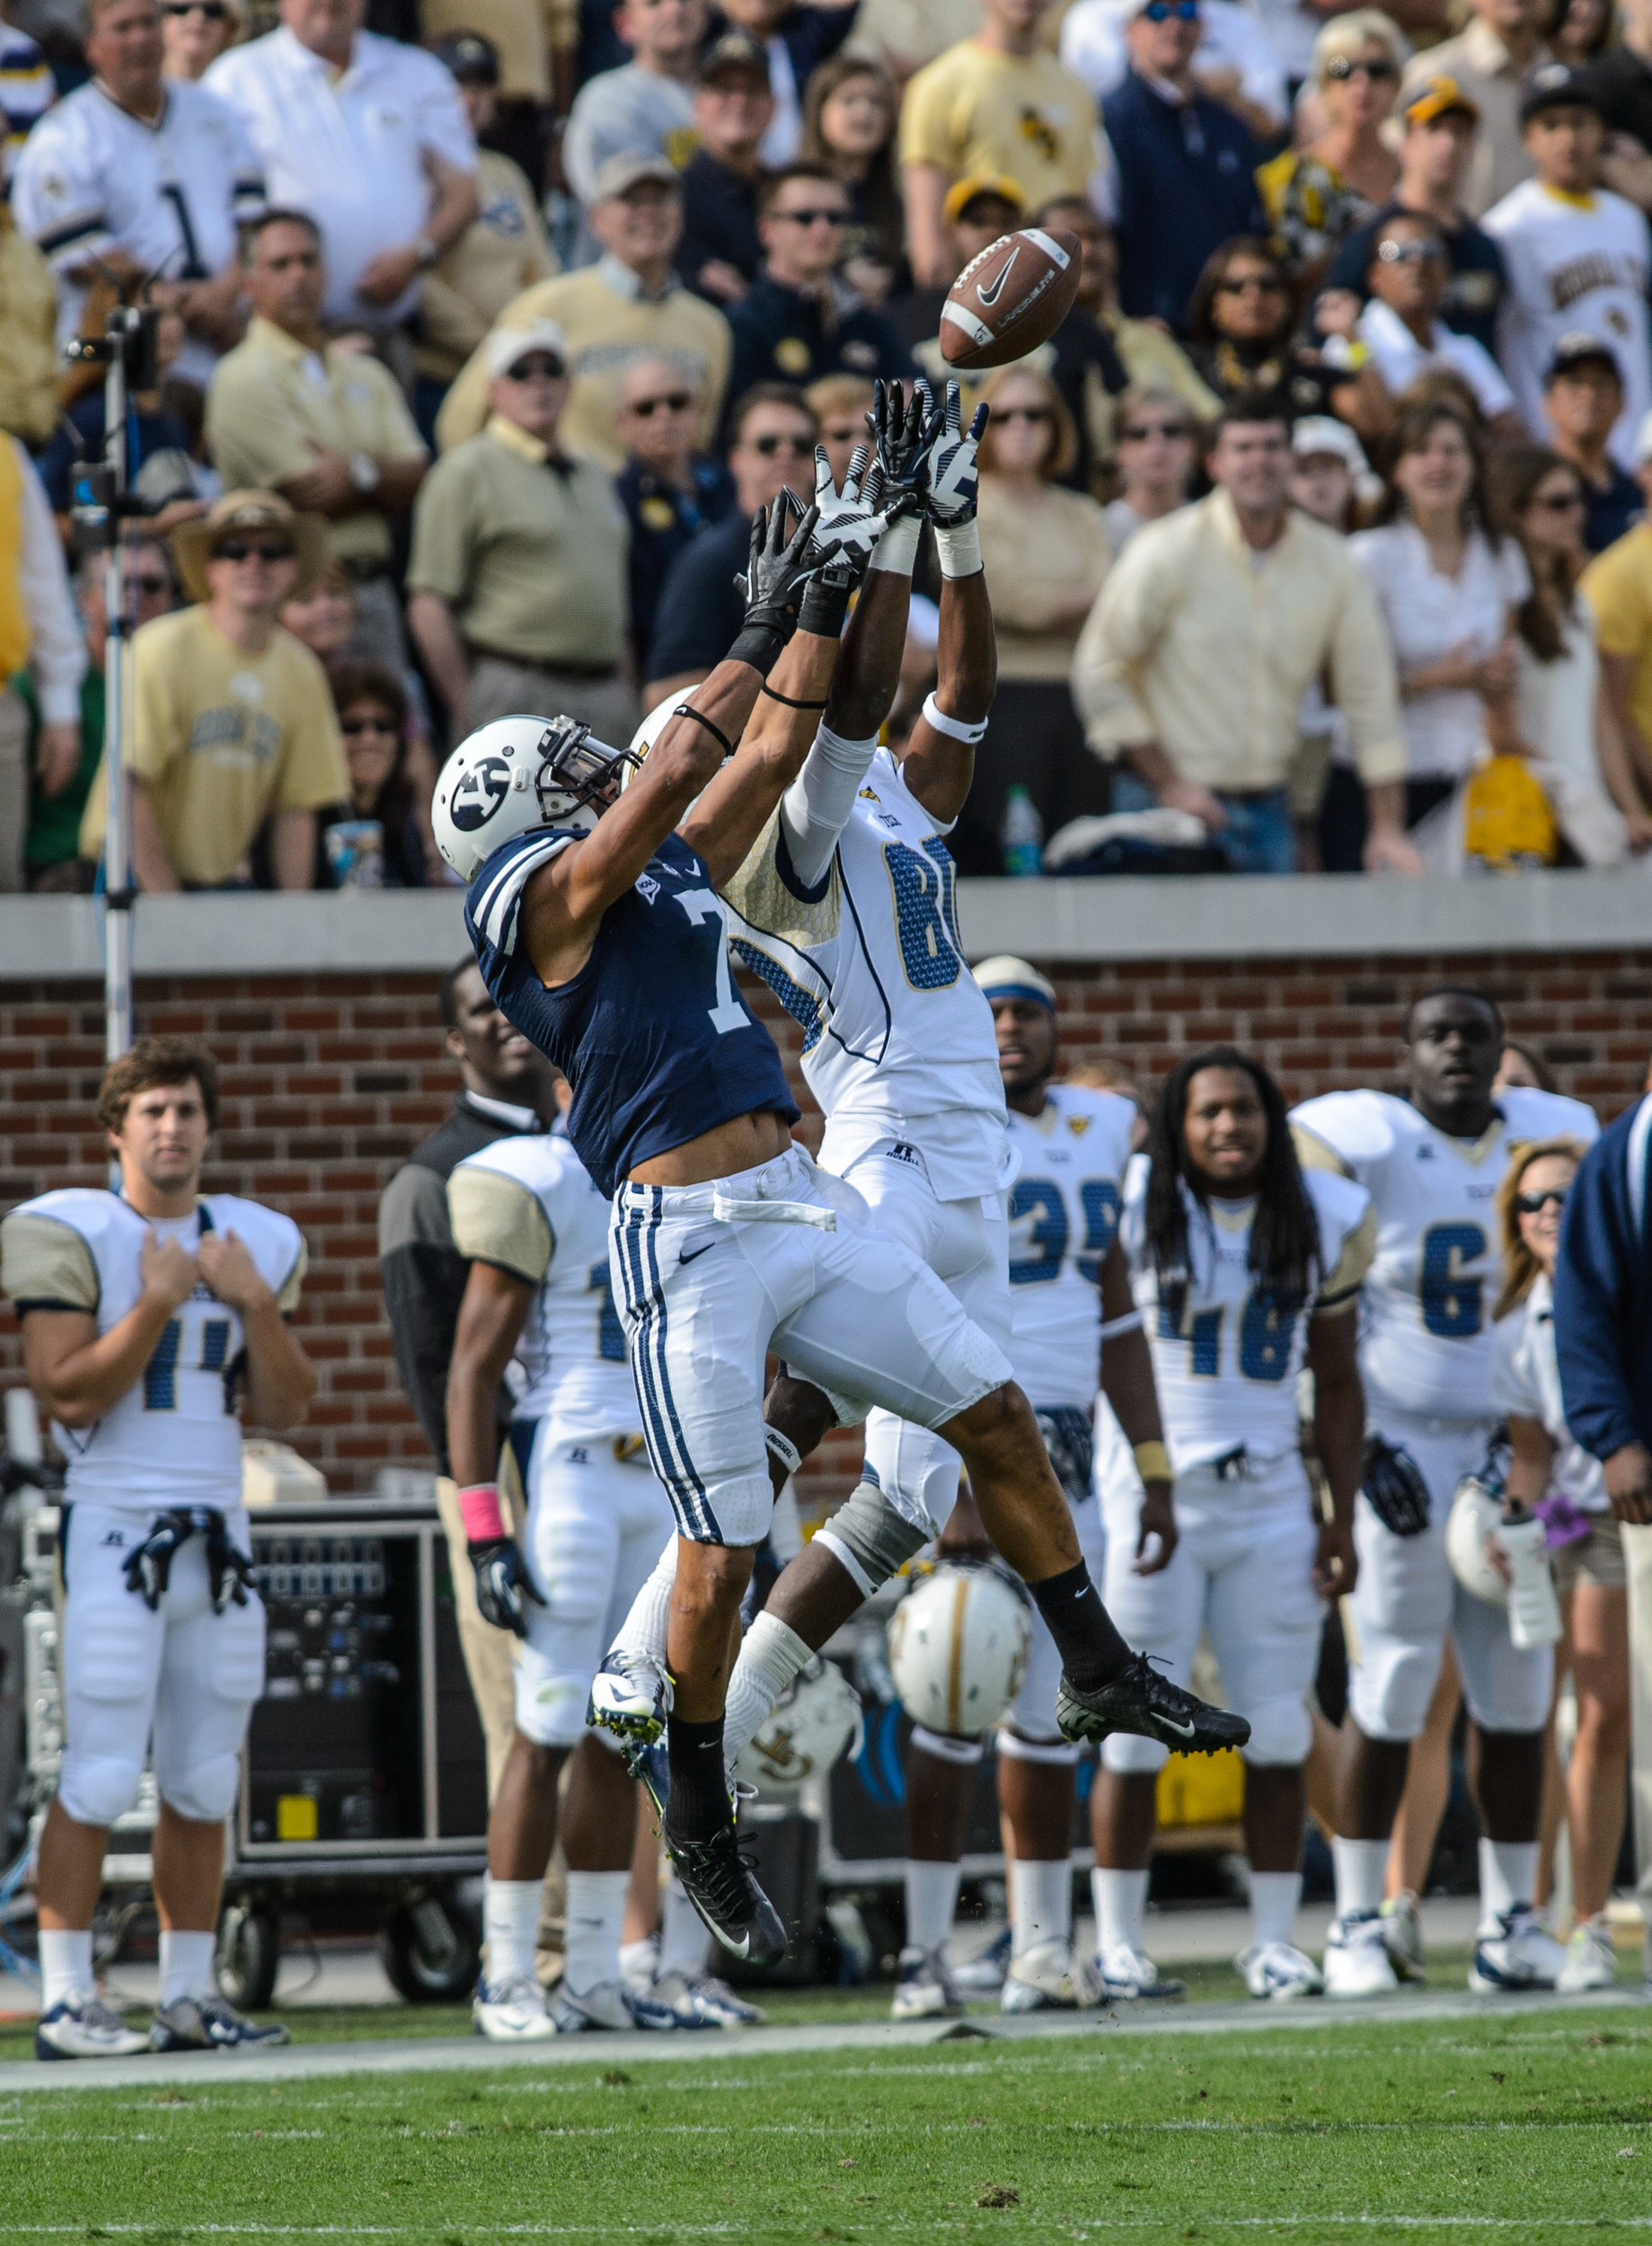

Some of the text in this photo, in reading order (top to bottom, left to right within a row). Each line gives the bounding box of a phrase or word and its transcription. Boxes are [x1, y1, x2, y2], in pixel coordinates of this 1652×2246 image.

[158, 182, 211, 280] 1
[673, 888, 752, 1034] 7
[886, 1151, 920, 1166] RUSSELL
[1008, 1178, 1121, 1286] 39
[1420, 1218, 1488, 1337] 6
